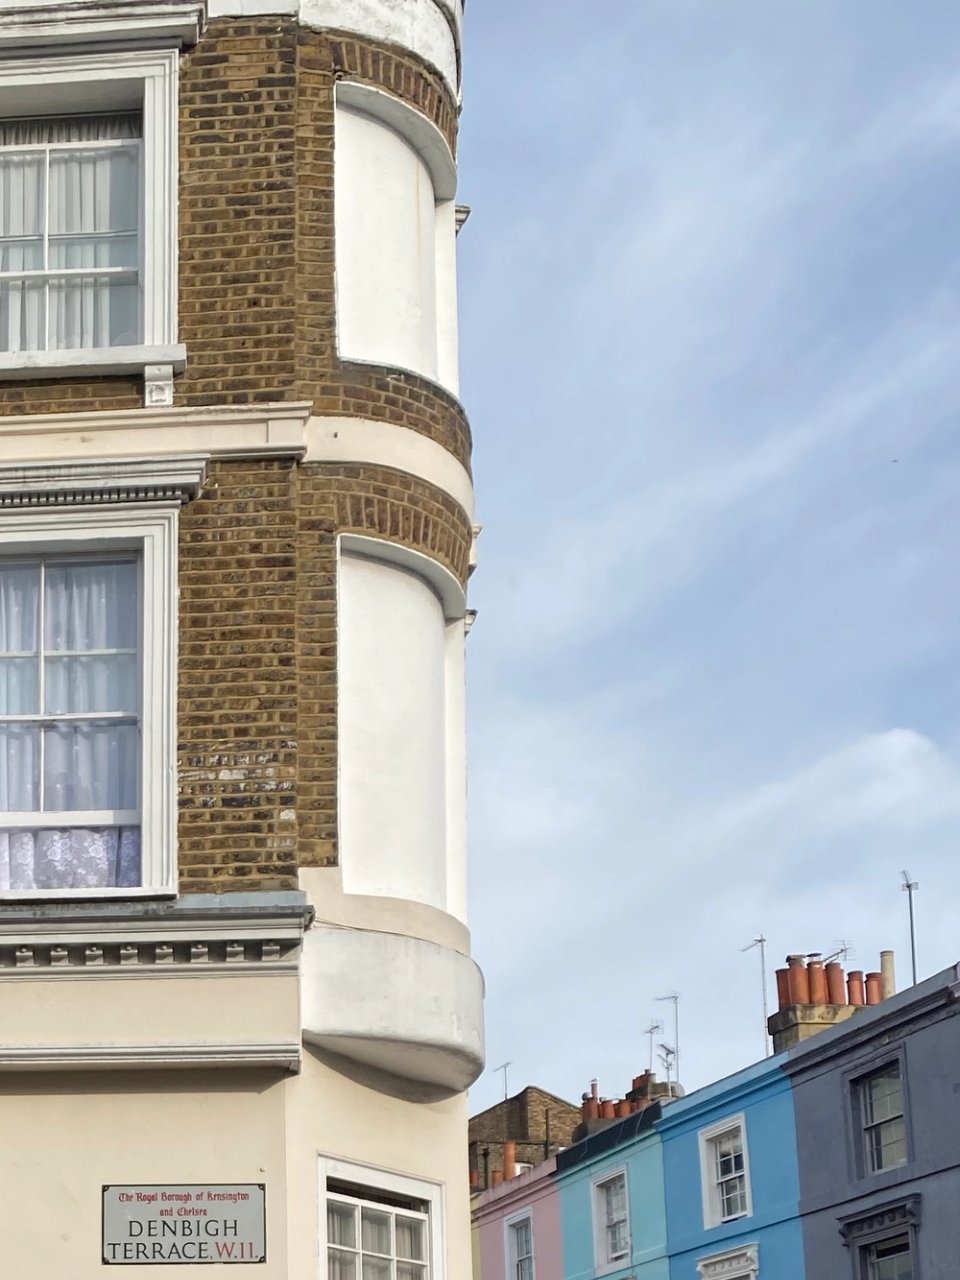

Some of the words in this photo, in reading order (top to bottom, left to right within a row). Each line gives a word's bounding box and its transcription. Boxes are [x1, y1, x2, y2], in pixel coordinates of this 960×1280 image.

[119, 1192, 133, 1202] The
[136, 1192, 158, 1204] Royal
[161, 1192, 192, 1204] Borough
[196, 1192, 204, 1201] of
[207, 1191, 250, 1203] Kensington
[159, 1207, 173, 1216] and
[177, 1207, 208, 1216] Chelsea
[128, 1219, 239, 1237] DENBIGH
